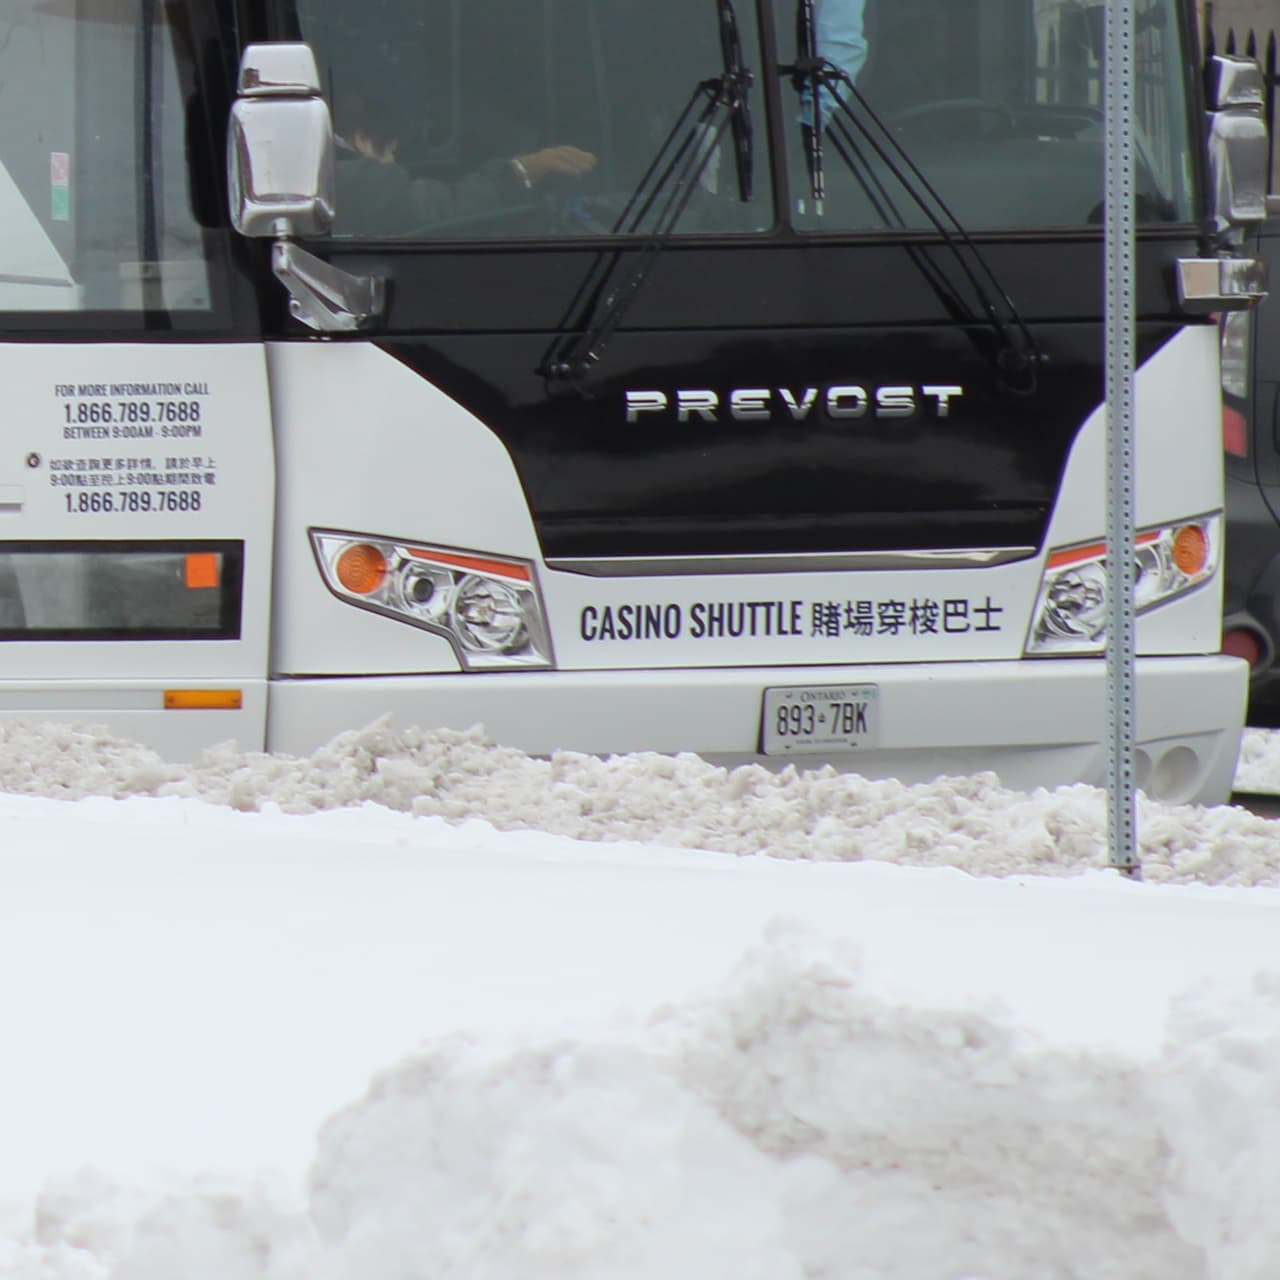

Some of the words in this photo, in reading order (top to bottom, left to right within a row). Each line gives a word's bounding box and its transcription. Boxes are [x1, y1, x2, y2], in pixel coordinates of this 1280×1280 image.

[55, 384, 75, 397] FOR
[78, 384, 108, 397] MORE
[110, 383, 182, 396] INFORMATION
[184, 383, 209, 395] CALL
[64, 401, 200, 423] 1.866.789.7688
[625, 385, 963, 422] PREVOST
[64, 426, 109, 439] BETWEEN
[112, 426, 153, 438] 9:00AM
[161, 425, 202, 438] 9:00PM
[65, 491, 201, 512] 1.866.789.7688
[580, 604, 680, 641] CASINO
[689, 601, 803, 638] SHUTTLE
[810, 596, 1003, 638] 賭場穿梭巴士
[777, 703, 815, 736] 893
[829, 702, 869, 734] 7BK
